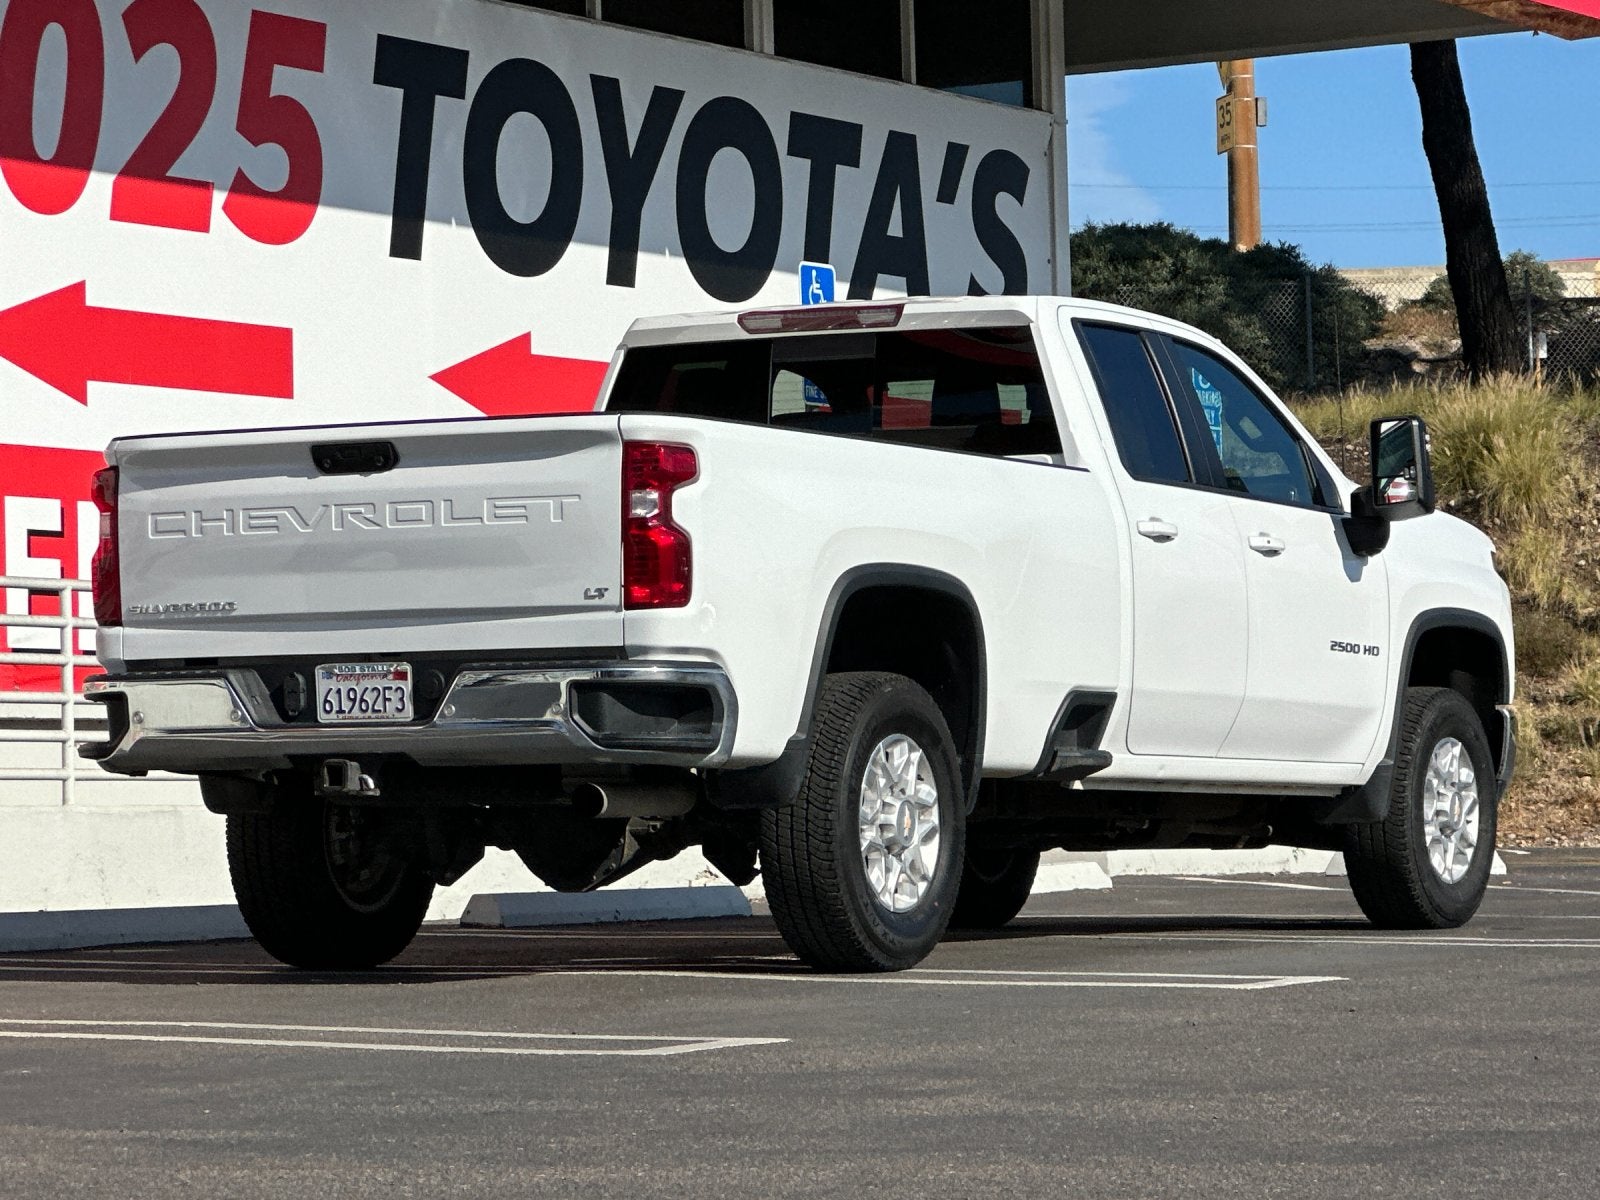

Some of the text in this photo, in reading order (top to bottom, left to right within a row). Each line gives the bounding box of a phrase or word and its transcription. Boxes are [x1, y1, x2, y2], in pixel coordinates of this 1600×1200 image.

[1219, 102, 1232, 129] 35
[373, 34, 1031, 303] TOYOTA'S
[148, 494, 581, 539] CHEVROLET
[583, 587, 609, 601] LT
[128, 601, 238, 615] SILVERADO
[1330, 640, 1380, 657] 2500 HD
[323, 686, 406, 715] 61962F3
